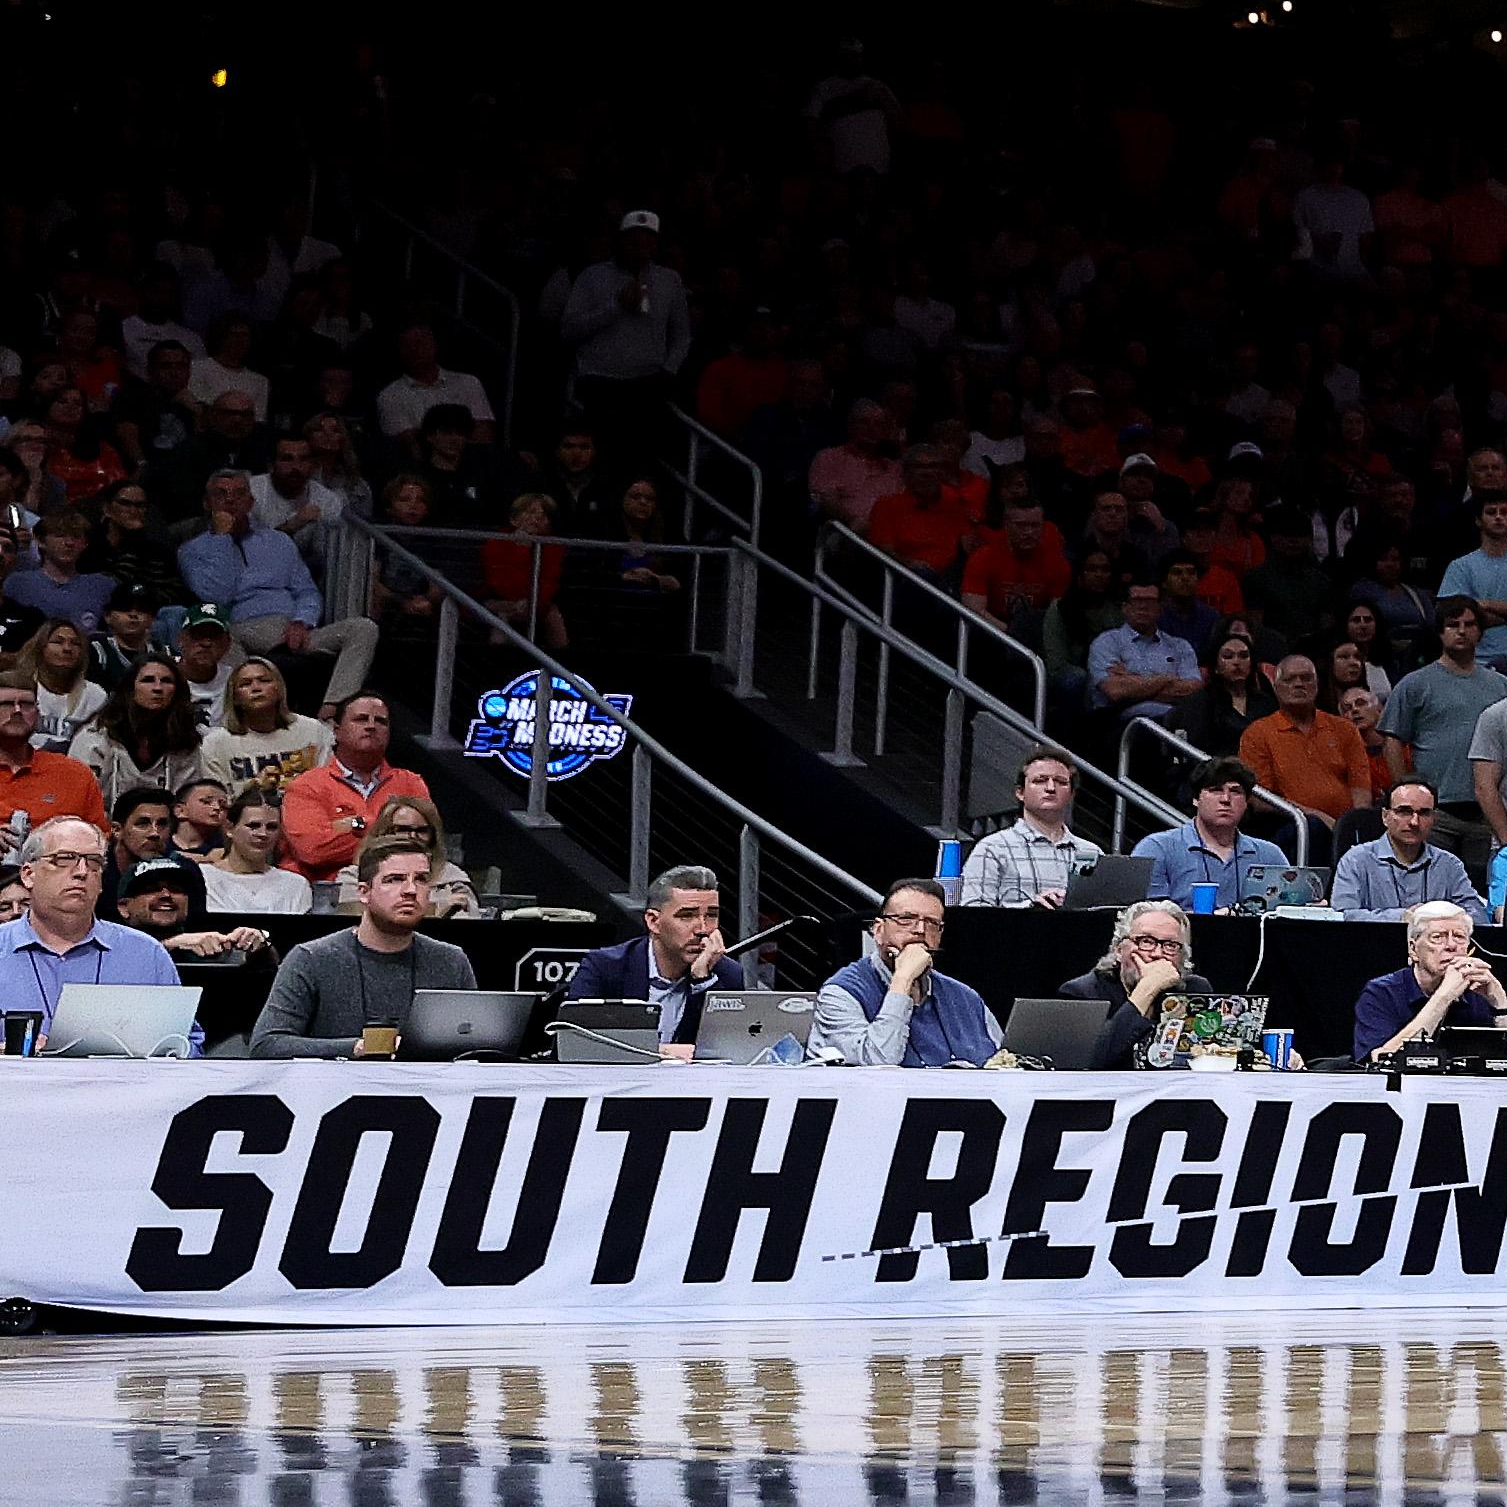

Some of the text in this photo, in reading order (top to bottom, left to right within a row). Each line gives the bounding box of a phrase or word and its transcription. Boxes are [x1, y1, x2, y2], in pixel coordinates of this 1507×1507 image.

[513, 721, 623, 748] MDNESS
[533, 961, 581, 982] 107
[125, 1094, 839, 1293] SOUTH
